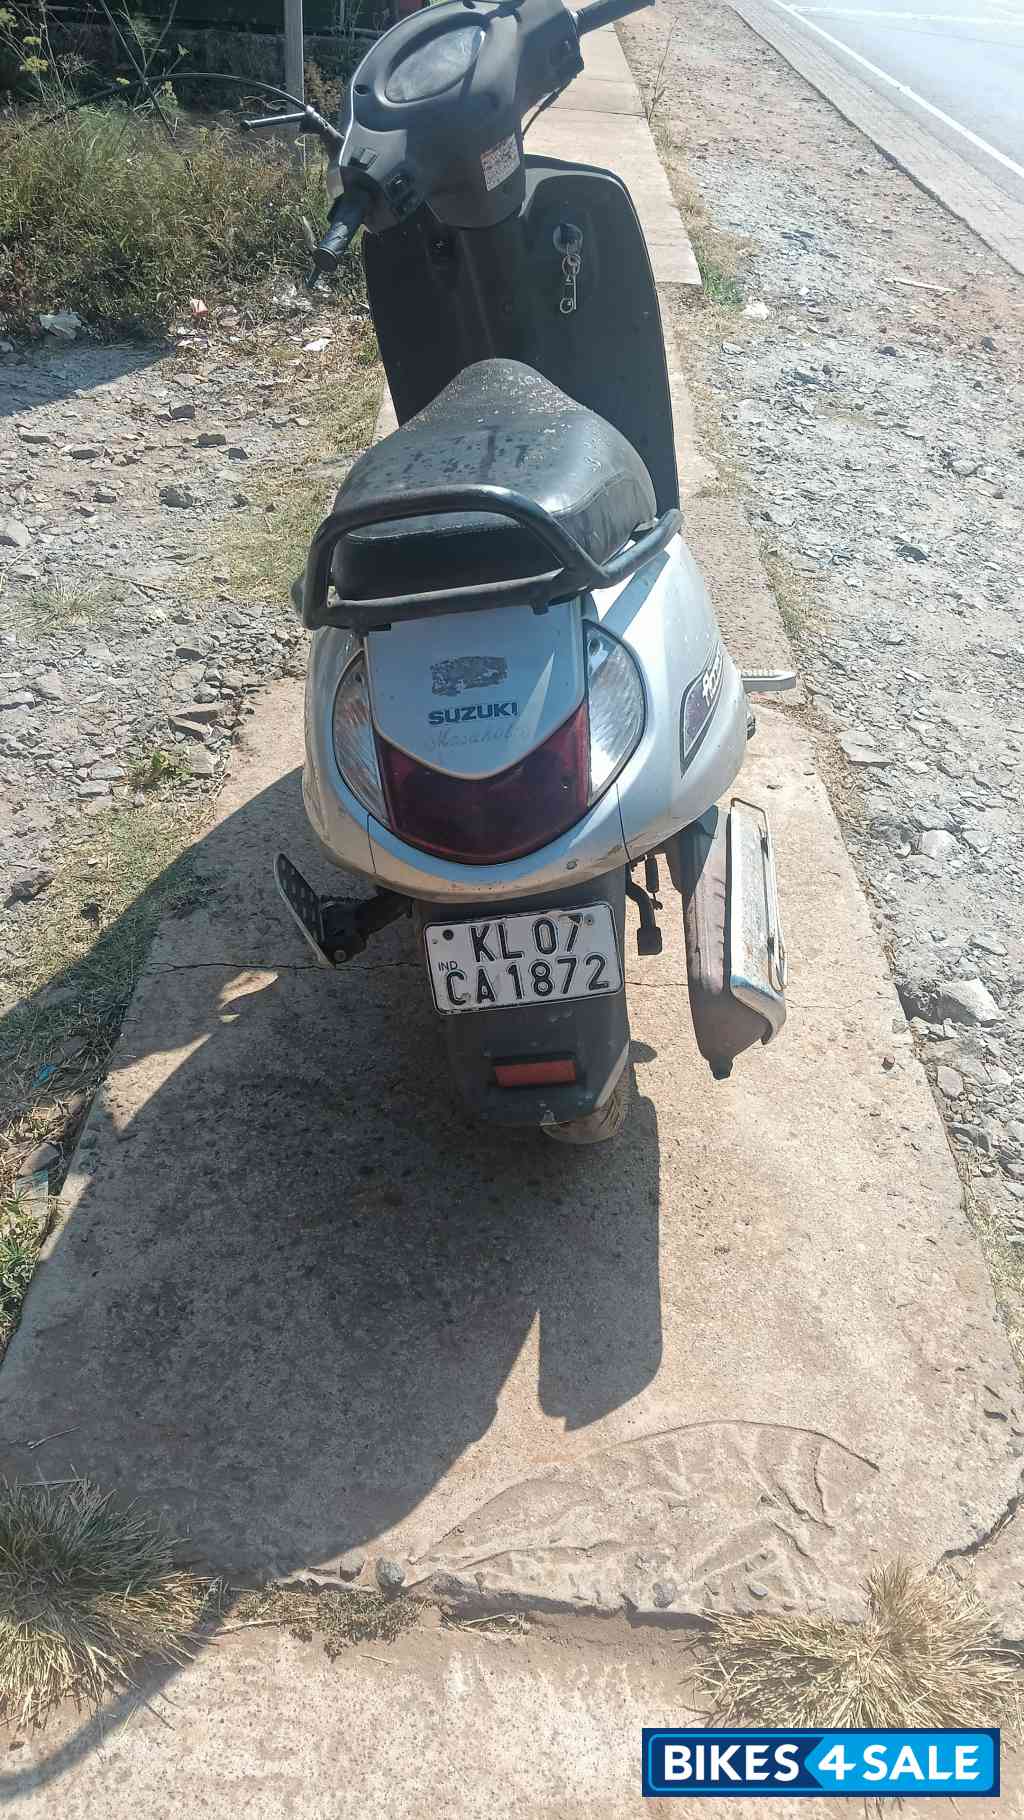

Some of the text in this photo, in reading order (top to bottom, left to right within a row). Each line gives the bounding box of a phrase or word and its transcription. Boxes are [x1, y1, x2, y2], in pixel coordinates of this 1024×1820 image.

[428, 702, 518, 725] SUZUKI
[471, 913, 584, 962] KL 07
[438, 961, 459, 971] IND
